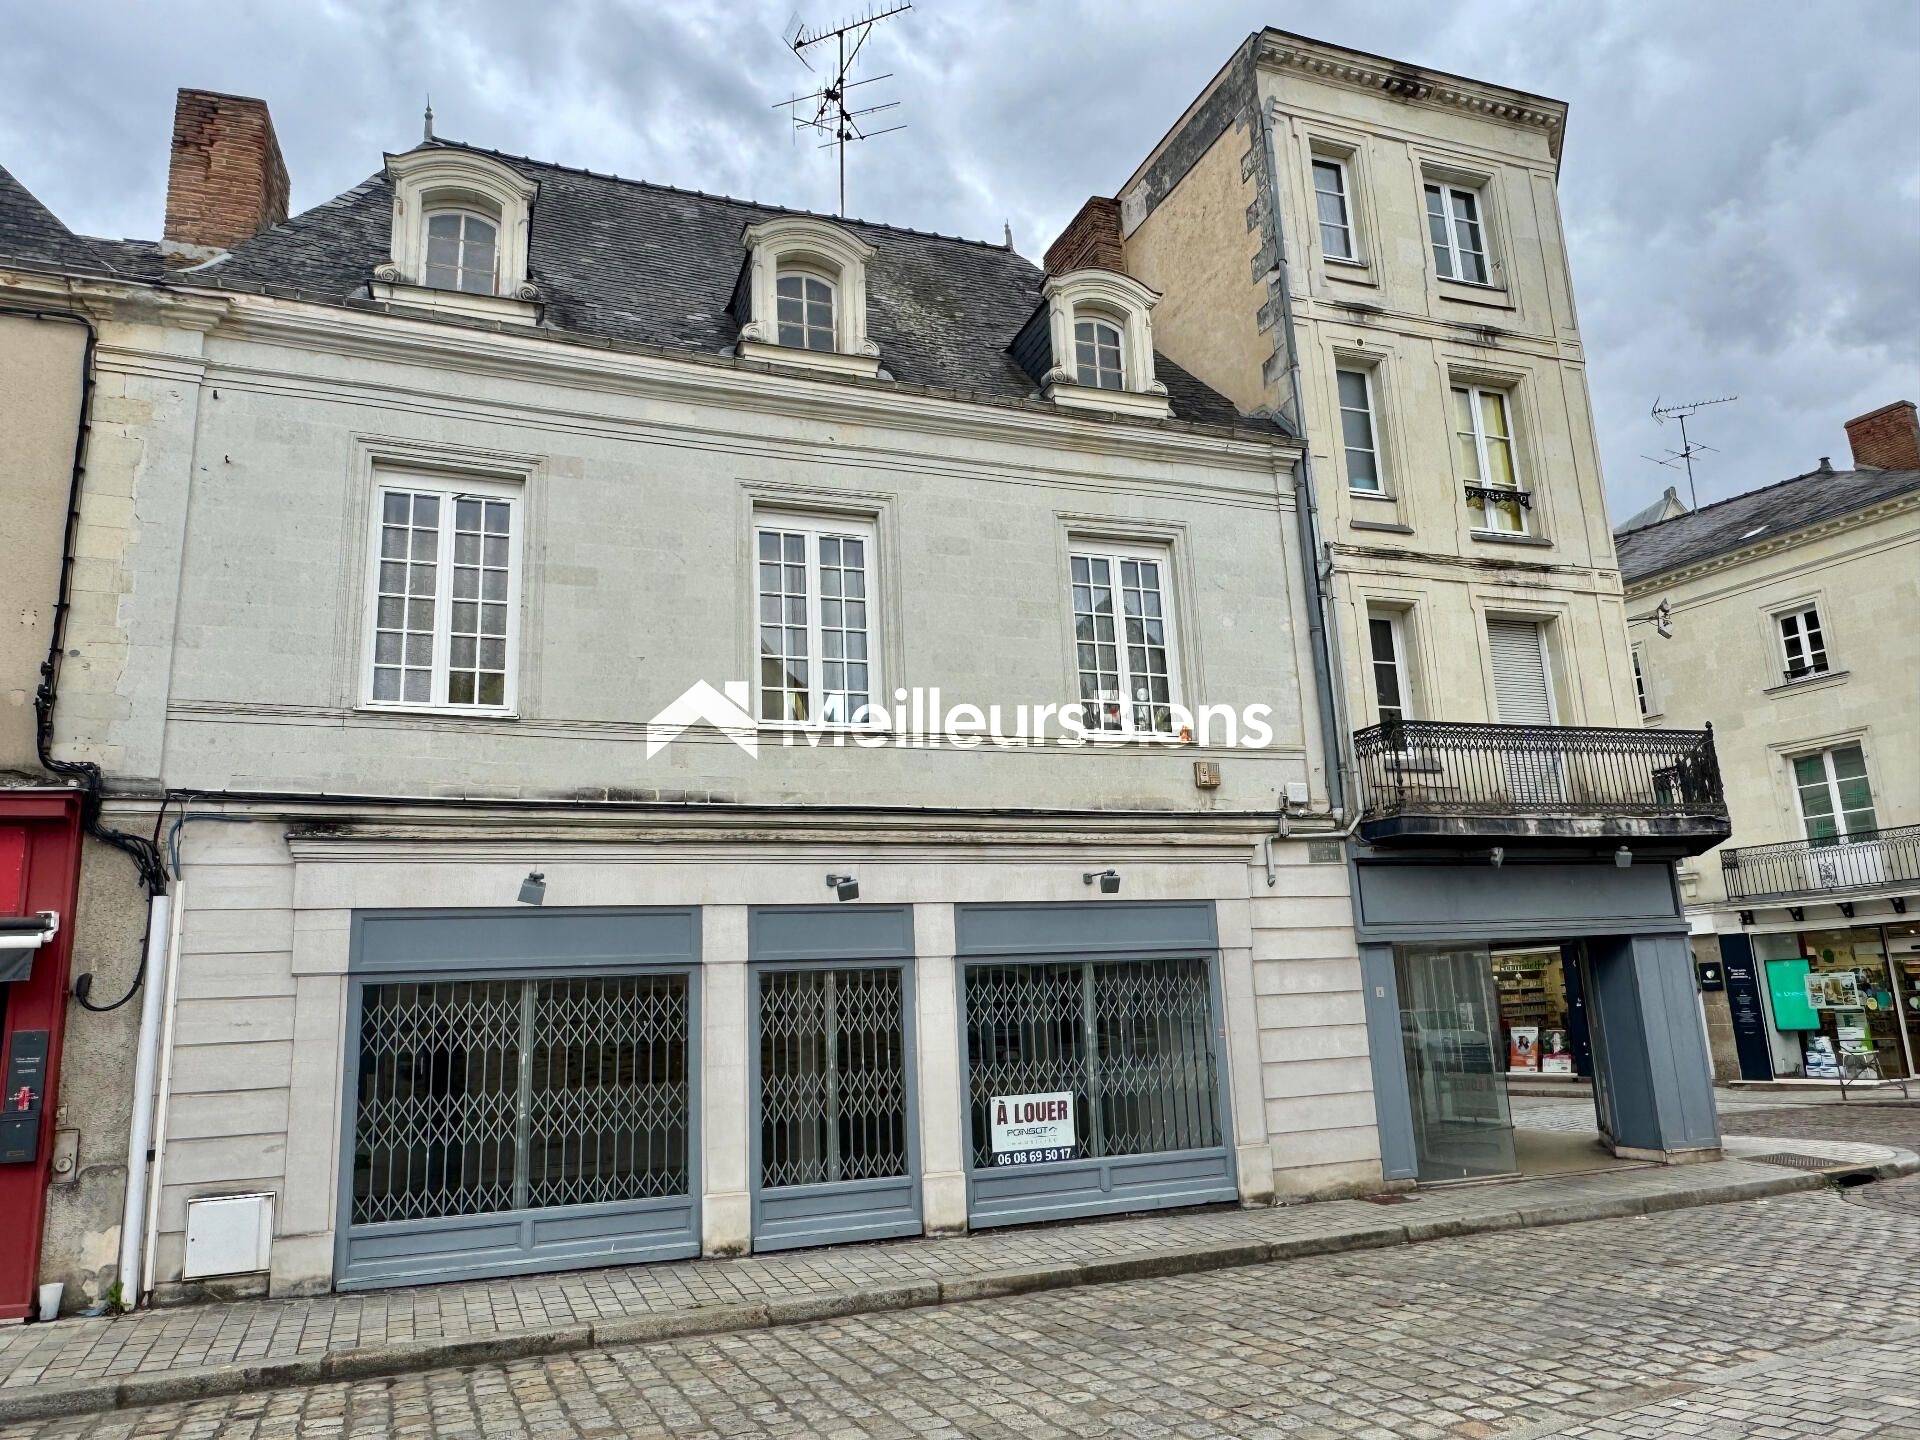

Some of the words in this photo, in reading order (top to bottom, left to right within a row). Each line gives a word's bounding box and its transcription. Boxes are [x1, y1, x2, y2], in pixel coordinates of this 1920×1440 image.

[997, 1100, 1008, 1125] À
[1014, 1100, 1068, 1124] LOUER
[998, 1153, 1011, 1165] 06
[1013, 1152, 1027, 1164] 08
[1029, 1150, 1042, 1162] 69
[1045, 1149, 1058, 1161] 50
[1060, 1148, 1072, 1160] 17
